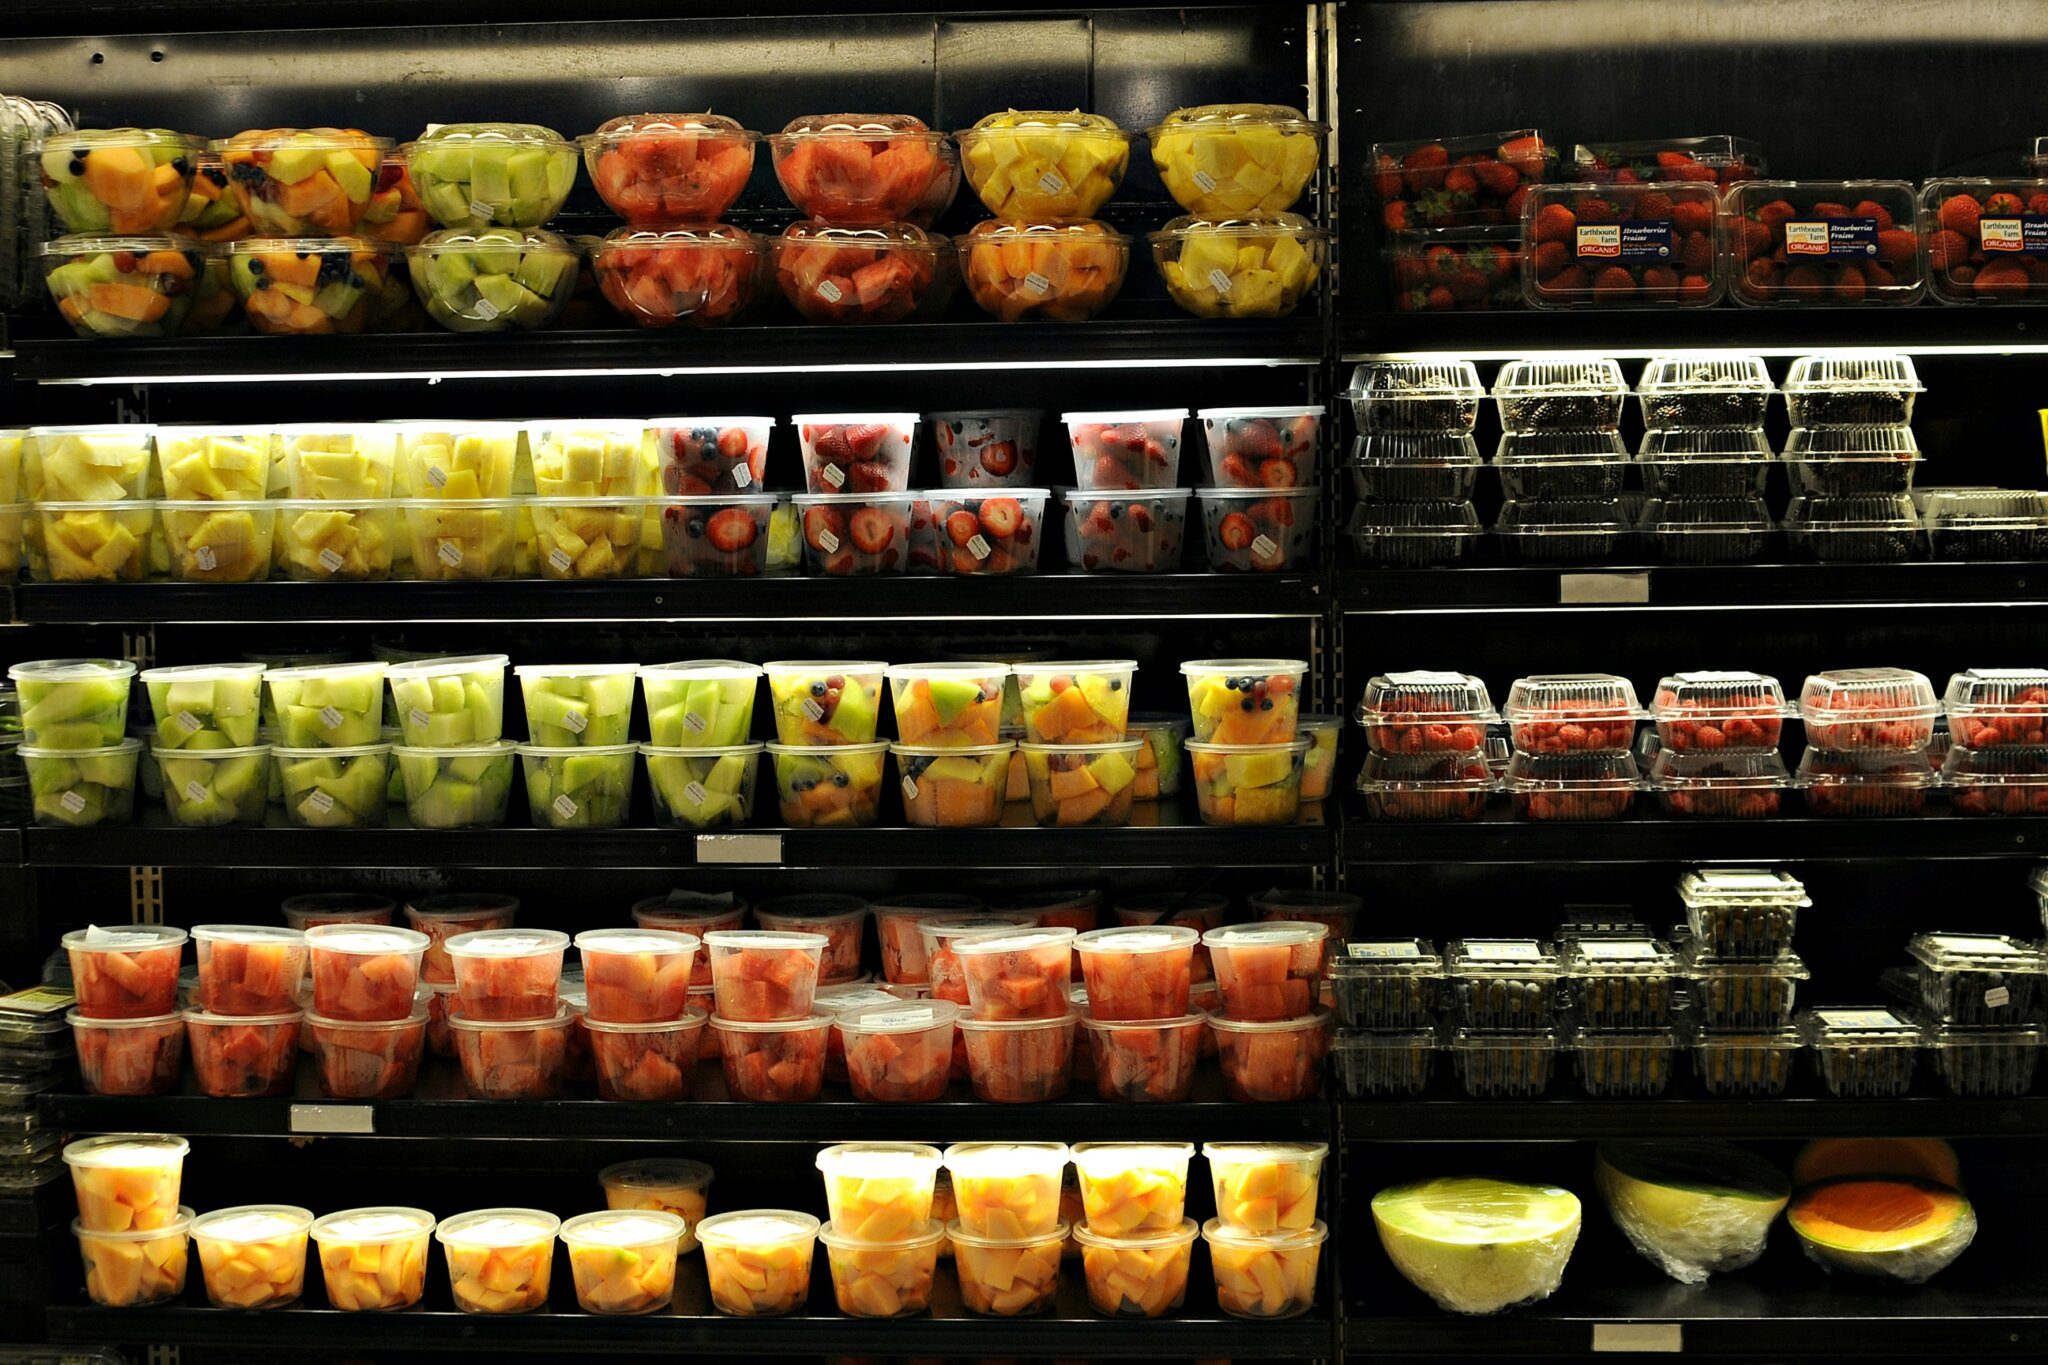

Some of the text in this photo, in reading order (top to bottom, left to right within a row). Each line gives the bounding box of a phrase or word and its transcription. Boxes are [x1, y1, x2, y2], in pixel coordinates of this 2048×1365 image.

[1789, 225, 1825, 233] Earthbound
[1830, 224, 1873, 232] Strawberries
[1983, 222, 2018, 230] Earthbound
[2024, 221, 2048, 229] Strawb
[1580, 228, 1617, 236] Earthbound
[2004, 230, 2019, 238] Farm
[1790, 243, 1825, 251] ORGANIC
[1985, 240, 2020, 248] ORGANIC
